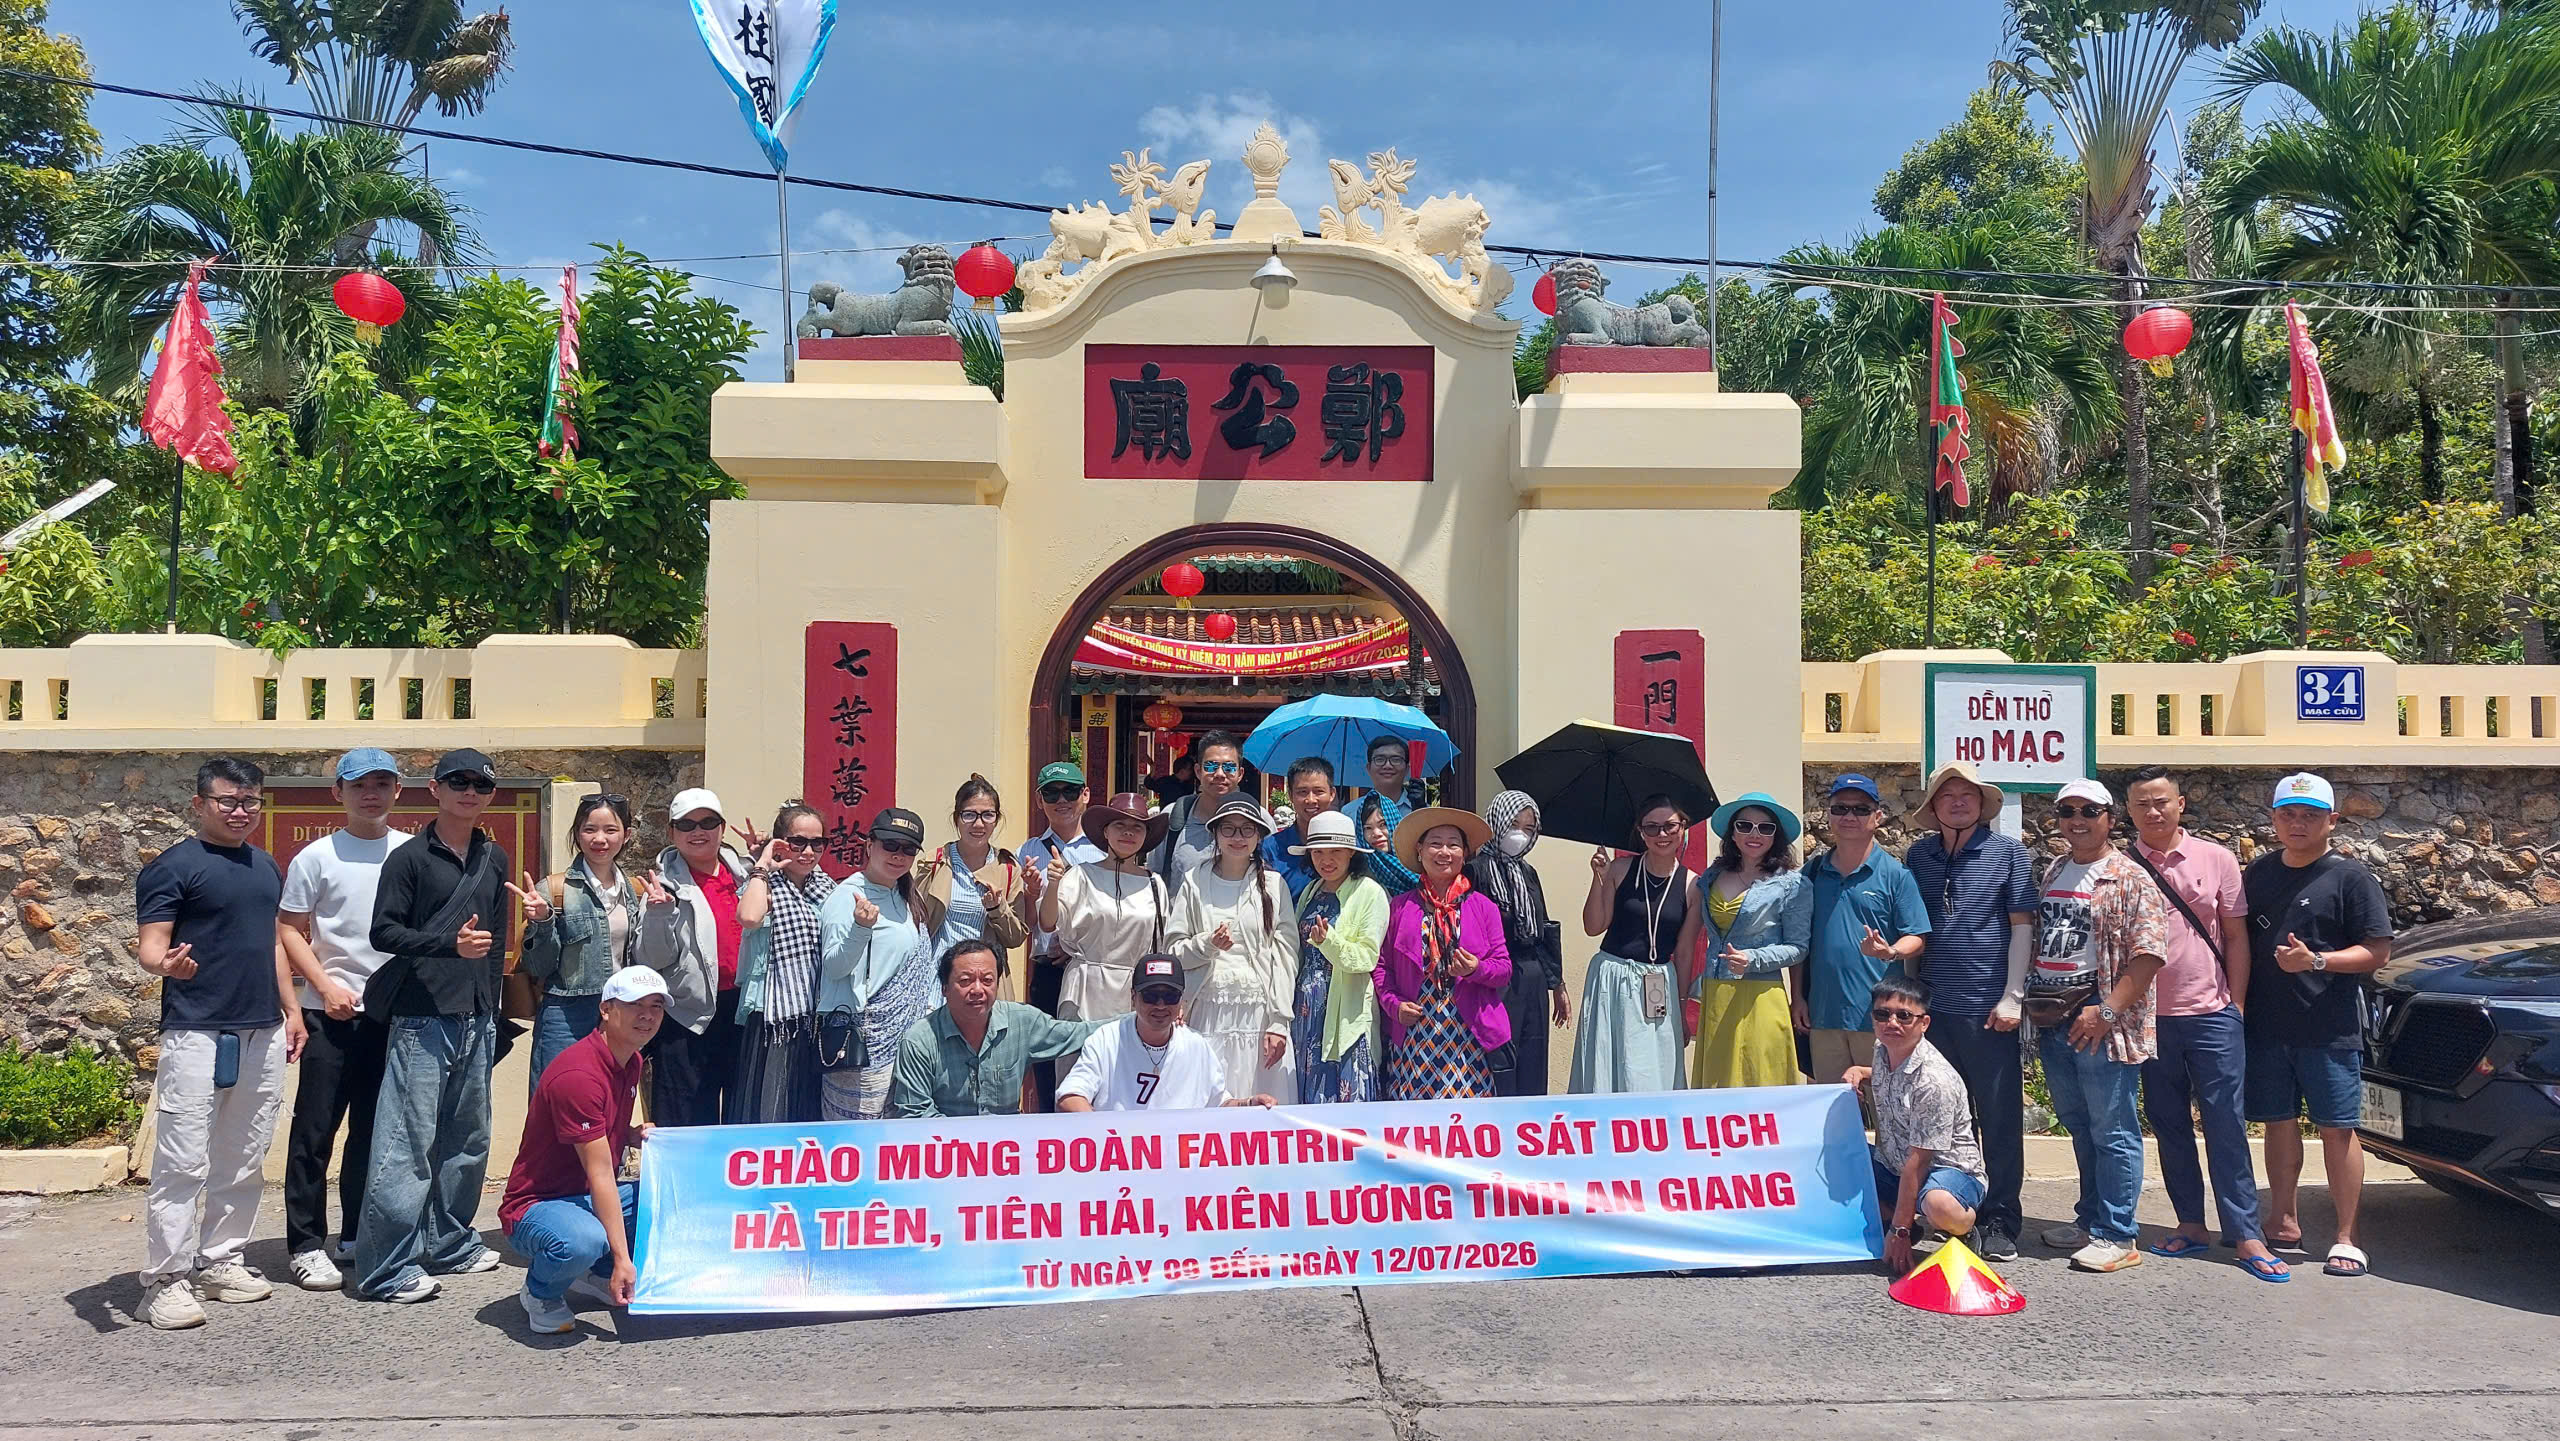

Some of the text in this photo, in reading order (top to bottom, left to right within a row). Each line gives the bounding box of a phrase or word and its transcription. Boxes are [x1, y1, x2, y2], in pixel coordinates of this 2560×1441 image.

[1215, 653, 1231, 668] 291
[1233, 651, 1255, 668] NĂM
[1257, 650, 1282, 667] NGÀY
[1341, 644, 1409, 666] 11/7/2026
[1640, 650, 1681, 726] 一門
[2303, 672, 2360, 705] 34
[1968, 689, 2008, 721] ĐỀN
[2305, 708, 2331, 716] MẠC
[1956, 729, 2065, 768] HỌ MẠC
[1136, 1072, 1160, 1105] 7
[728, 1112, 1780, 1186] CHÀO MỪNG ĐOÀN FAMTRIP KHẢO SÁT DU LỊCH
[733, 1171, 1796, 1250] HÀ TIÊN, TIÊN HẢI, KIÊN LƯƠNG TỈNH AN GIANG
[1022, 1258, 1063, 1289] TỪ
[1070, 1256, 1153, 1287] NGÀY
[1208, 1246, 1270, 1279] ĐẾN
[1280, 1245, 1360, 1278] NGÀY
[1371, 1240, 1538, 1273] 12/07/2026
